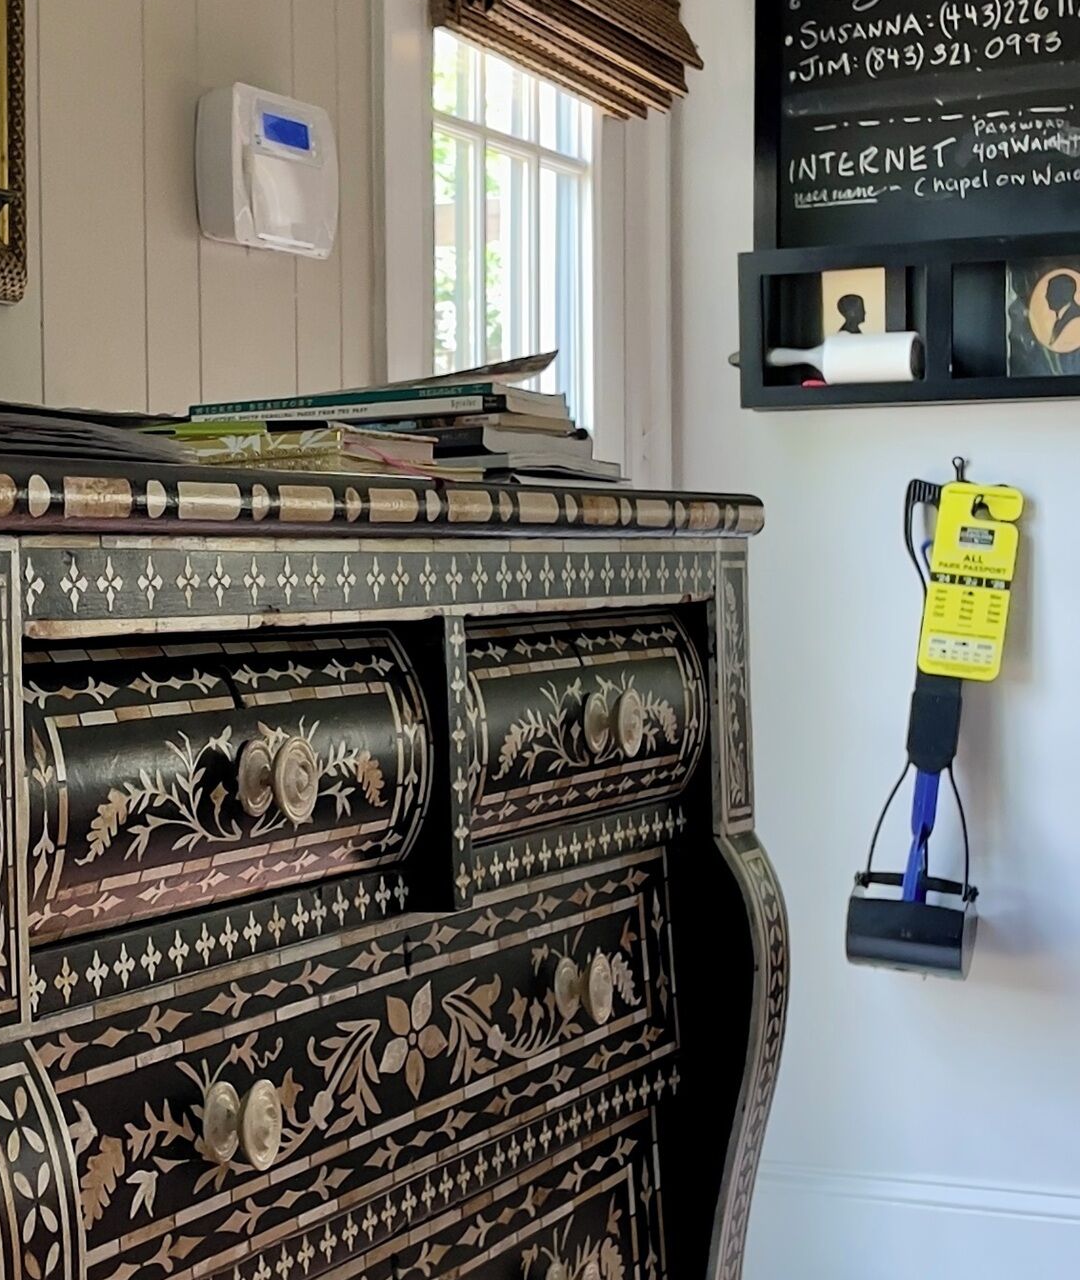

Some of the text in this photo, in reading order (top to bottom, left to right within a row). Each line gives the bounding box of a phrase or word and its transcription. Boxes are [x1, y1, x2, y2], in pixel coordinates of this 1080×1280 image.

[800, 13, 934, 50] SUSANNA:
[799, 53, 858, 81] JIM:
[865, 42, 924, 78] (843)
[984, 31, 1062, 59] 0993
[789, 137, 957, 184] INTERNET
[914, 169, 989, 199] Chapel
[250, 399, 314, 411] BEAUFORT
[963, 554, 983, 564] ALL
